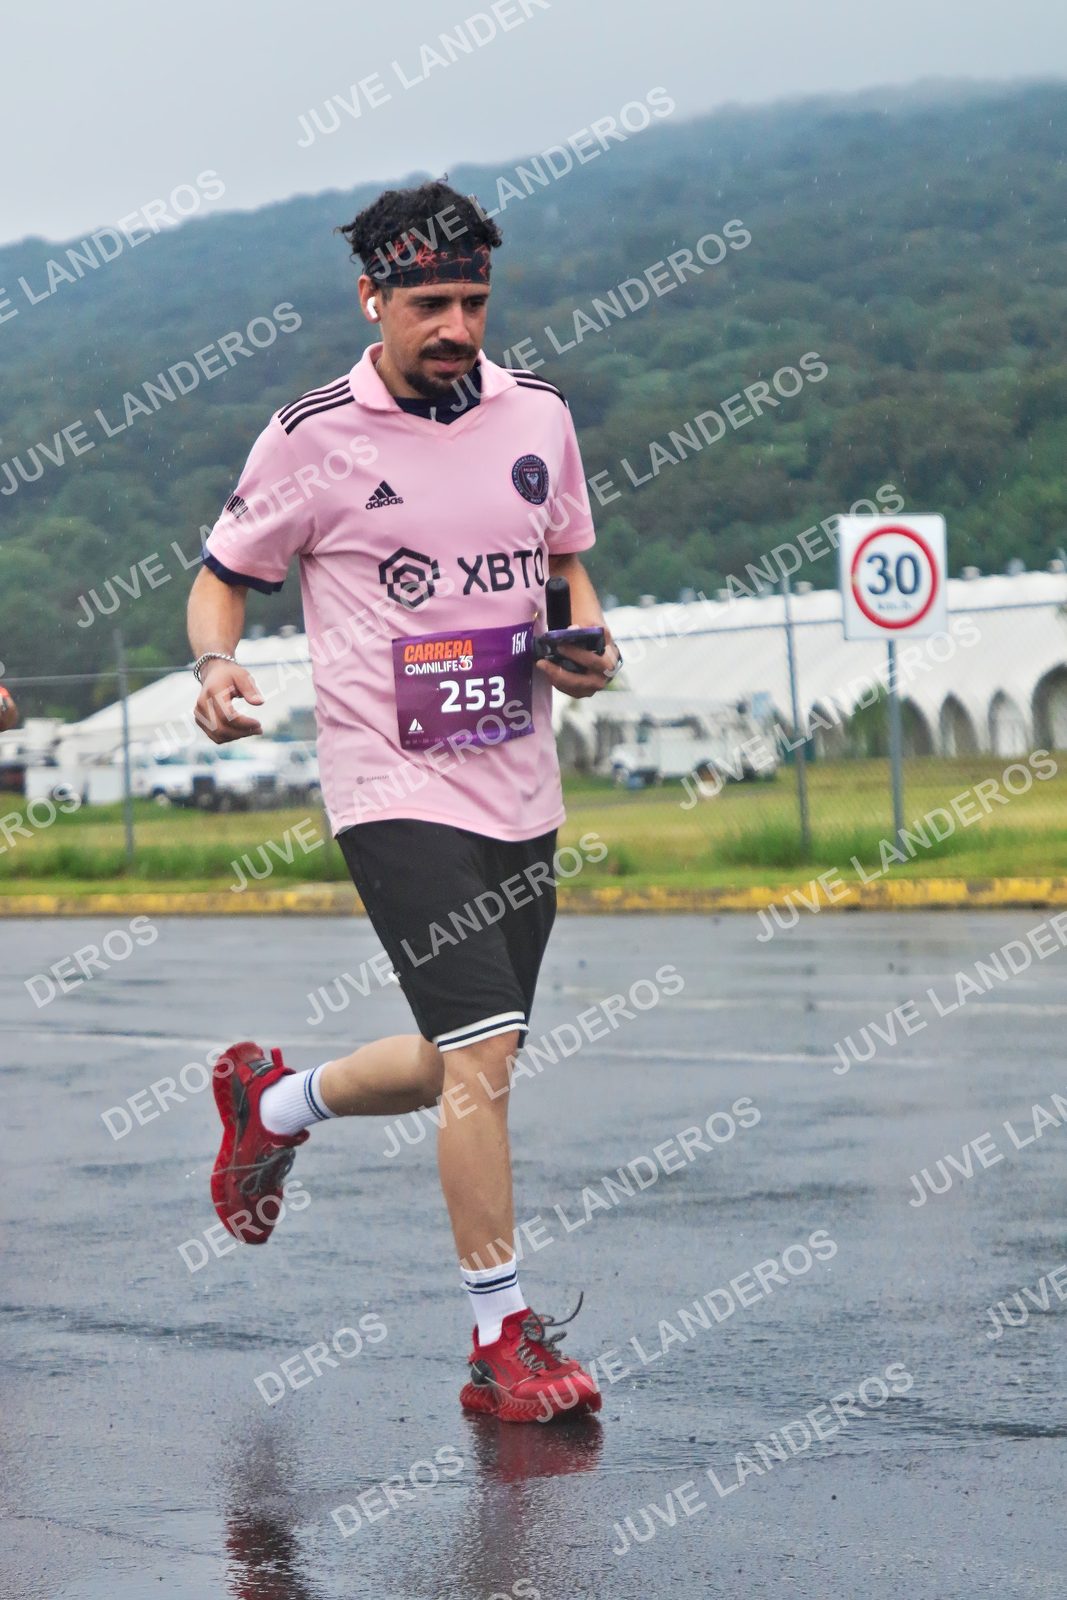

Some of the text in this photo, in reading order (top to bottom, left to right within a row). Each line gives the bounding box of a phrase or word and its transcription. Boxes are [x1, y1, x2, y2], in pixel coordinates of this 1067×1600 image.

[365, 496, 404, 510] adidas
[457, 547, 545, 596] XBTO
[866, 552, 921, 596] 30
[404, 639, 473, 663] CARRERA
[511, 631, 528, 655] 15K
[405, 660, 458, 675] OMNILIFE
[439, 675, 506, 713] 253
